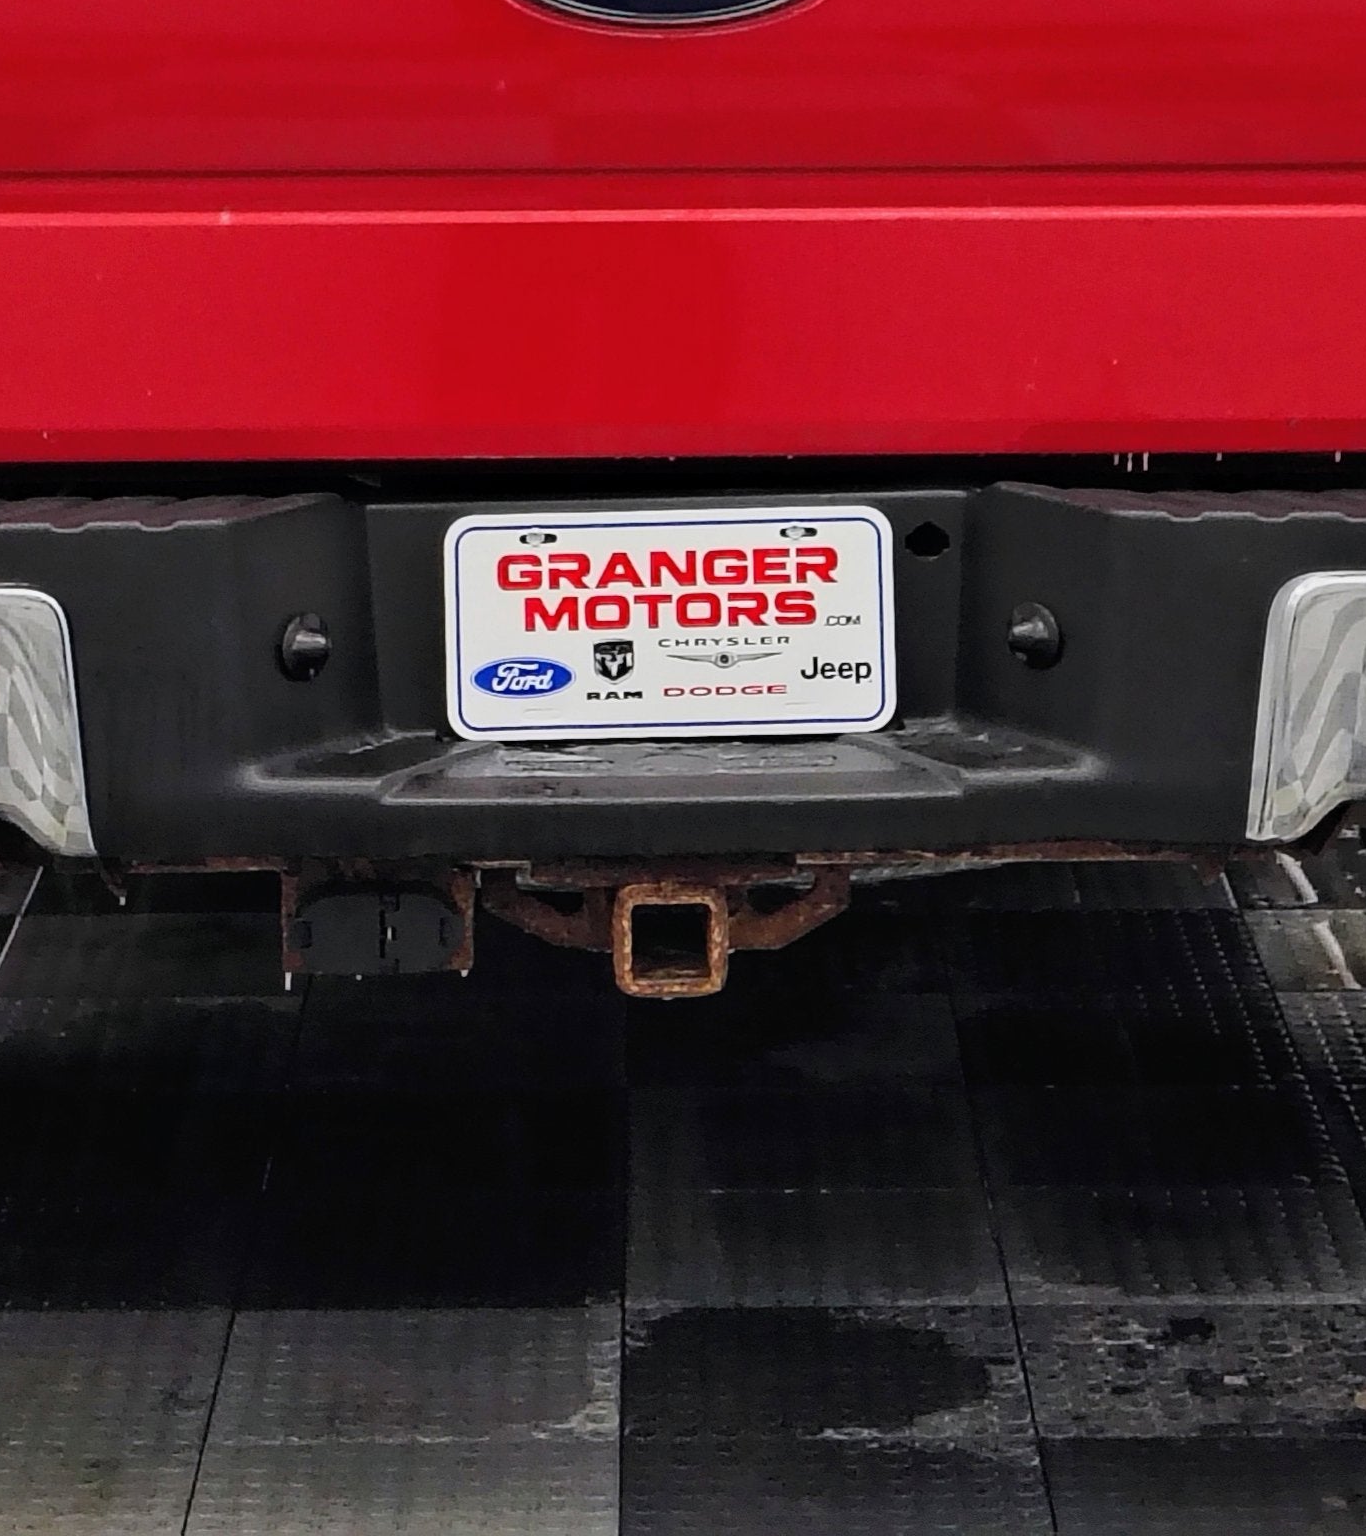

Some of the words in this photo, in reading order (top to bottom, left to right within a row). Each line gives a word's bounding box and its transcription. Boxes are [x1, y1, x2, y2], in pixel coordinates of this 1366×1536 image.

[497, 547, 839, 591] GRANGER
[524, 590, 817, 632] MOTORS
[658, 636, 790, 647] CHRYSLER
[492, 663, 554, 691] Ford
[800, 656, 872, 684] Jeep
[587, 691, 643, 700] RAM
[663, 685, 787, 697] DODGE
